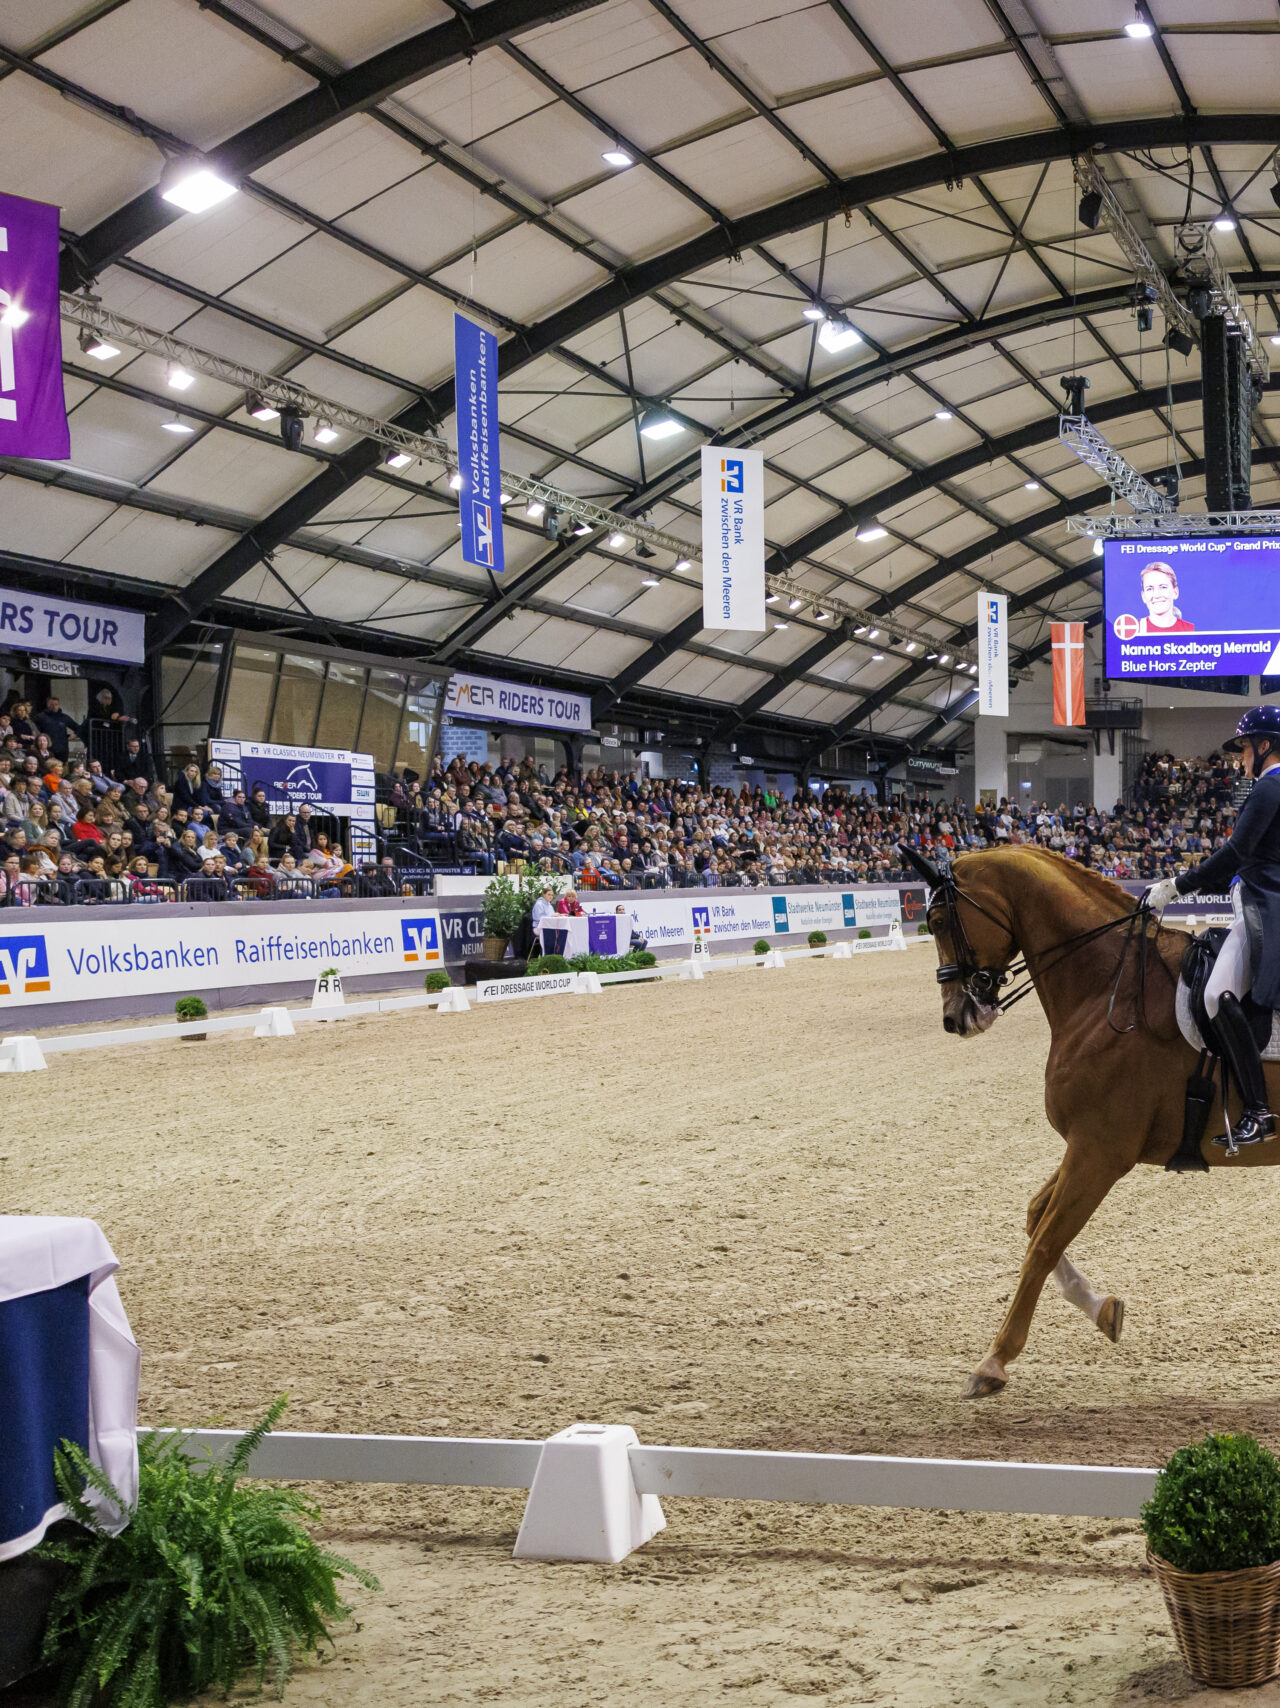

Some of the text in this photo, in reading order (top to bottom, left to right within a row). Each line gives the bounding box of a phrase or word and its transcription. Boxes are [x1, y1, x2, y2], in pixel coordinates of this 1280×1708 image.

[479, 331, 490, 499] Raiffeisenbanken
[469, 369, 480, 495] Volksbanken
[733, 499, 744, 545] VR Bank
[1121, 545, 1135, 554] FEI
[1137, 543, 1178, 555] Dressage
[1180, 542, 1206, 552] World
[1234, 541, 1260, 551] Grand
[1263, 540, 1280, 550] Prix
[721, 498, 732, 619] zwischen den Meeren
[43, 609, 119, 646] TOUR
[1121, 640, 1271, 658] Nanna Skodborg Merrald
[30, 659, 80, 676] S Block T
[1121, 659, 1217, 673] Blue Hors Zepter
[446, 681, 581, 721] EMER RIDERS TOUR
[272, 748, 297, 757] CLASSICS
[787, 899, 842, 914] Stadtwerke Neumünster
[855, 899, 877, 910] Stadtwerke
[1196, 894, 1232, 904] WORLD
[711, 904, 735, 918] VR Bank
[442, 918, 463, 940] VR
[646, 925, 658, 939] den
[660, 923, 684, 938] Meeren
[714, 919, 771, 934] zwischen den Meeren
[67, 931, 394, 975] Volksbanken Raiffeisenbanken
[461, 943, 484, 955] NEUM
[694, 944, 702, 953] B
[318, 979, 329, 992] R
[333, 979, 341, 992] R
[500, 983, 534, 995] DRESSAGE
[535, 980, 557, 991] WORLD
[558, 978, 571, 988] CUP
